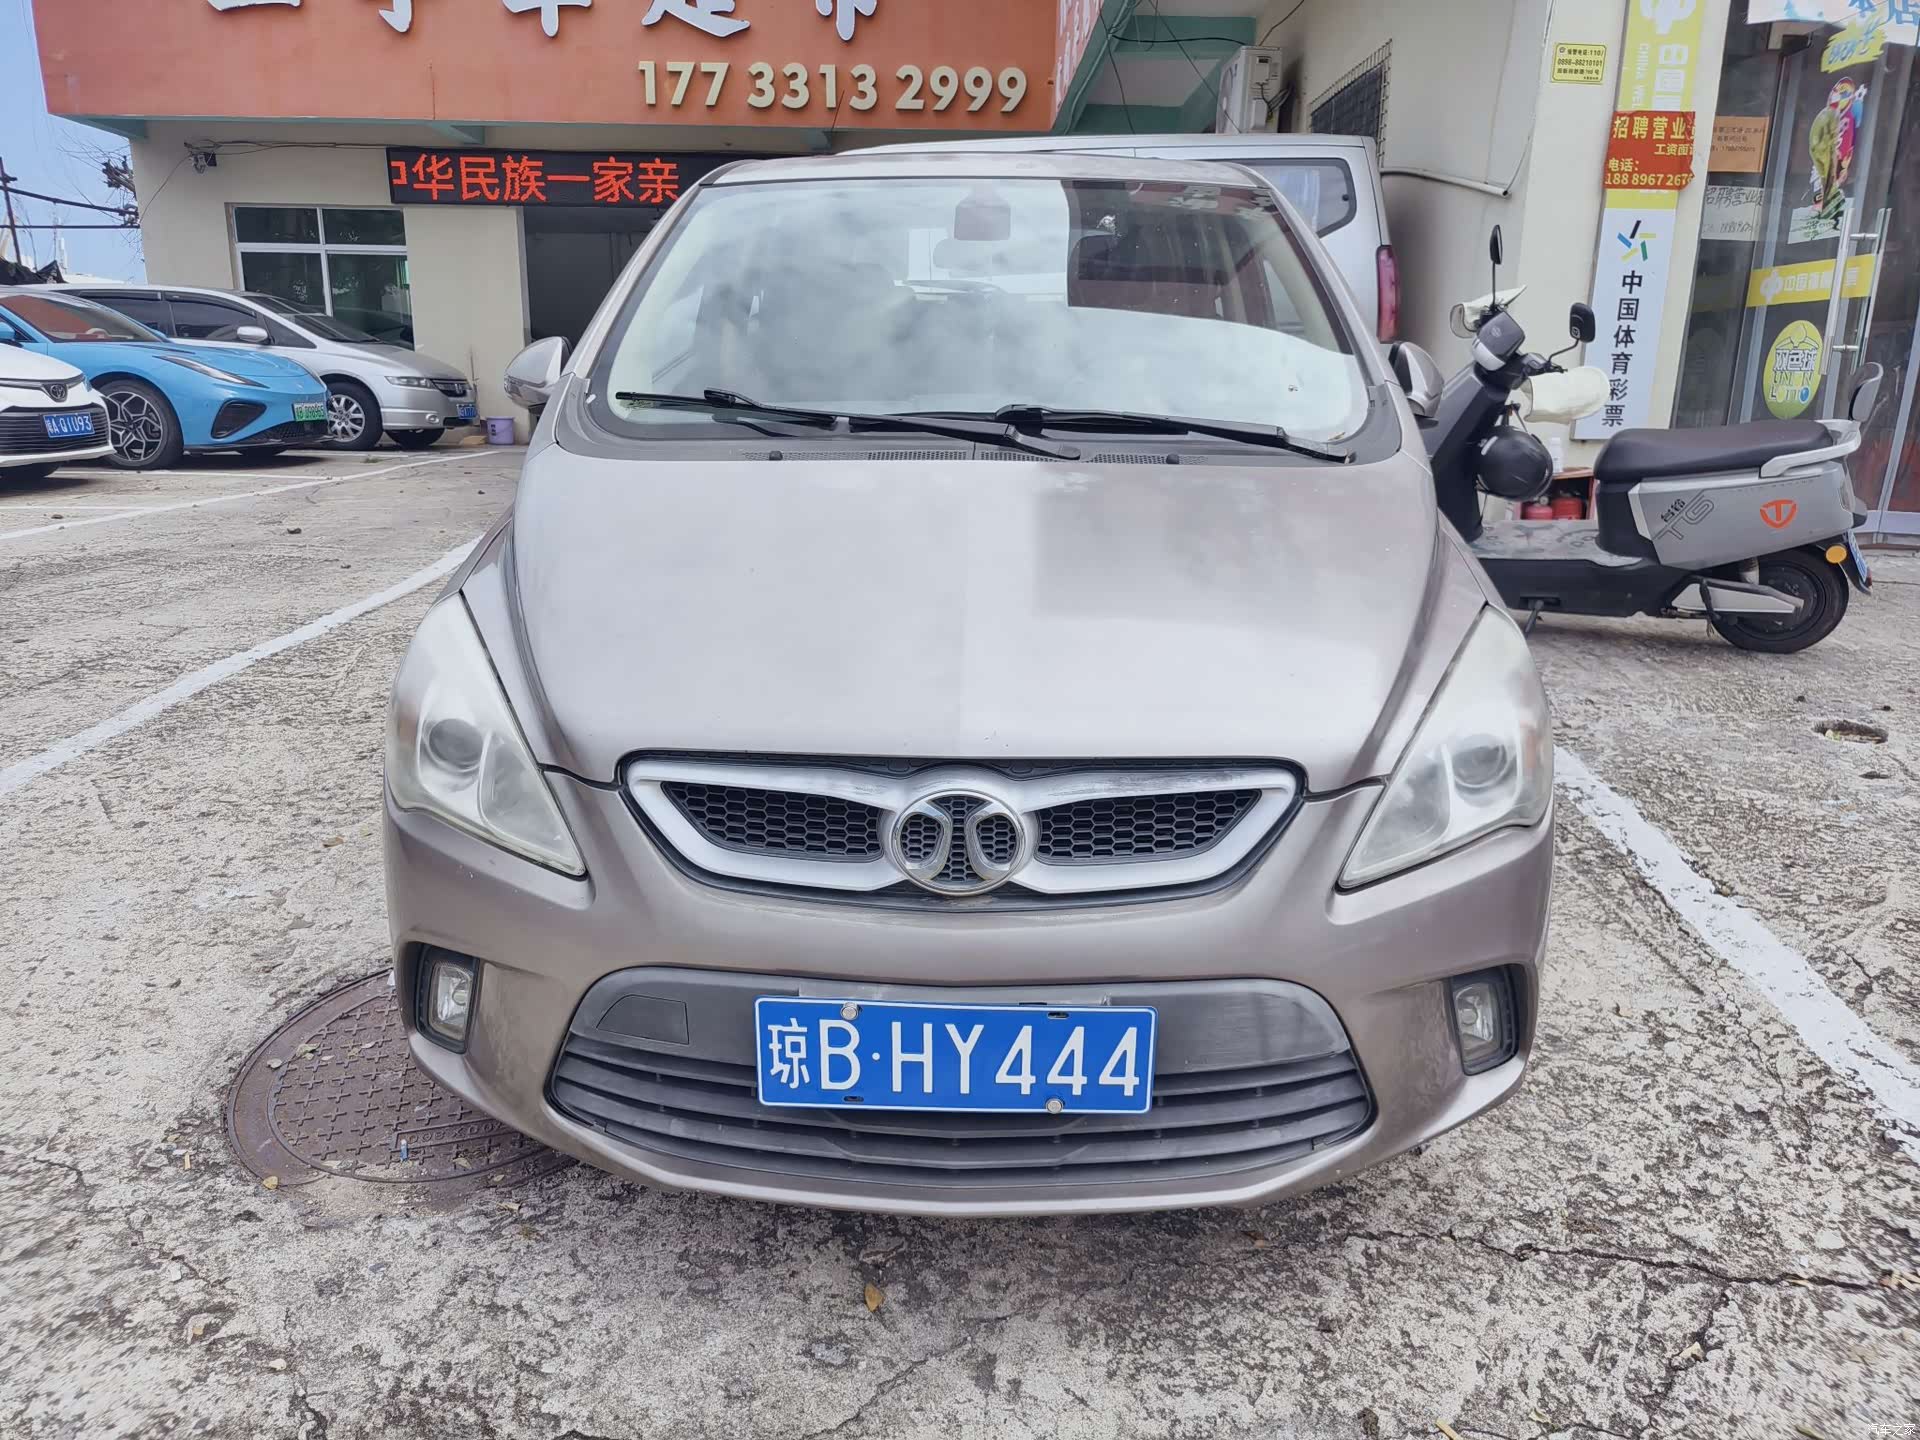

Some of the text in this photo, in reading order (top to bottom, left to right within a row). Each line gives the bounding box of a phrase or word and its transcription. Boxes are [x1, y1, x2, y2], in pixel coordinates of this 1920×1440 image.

[638, 60, 1027, 112] 177 3313 2999
[1605, 173, 1629, 185] 188
[1631, 173, 1664, 186] 8967
[1602, 270, 1643, 428] 中国体育彩票
[768, 1018, 1140, 1097] 琼B·HY444
